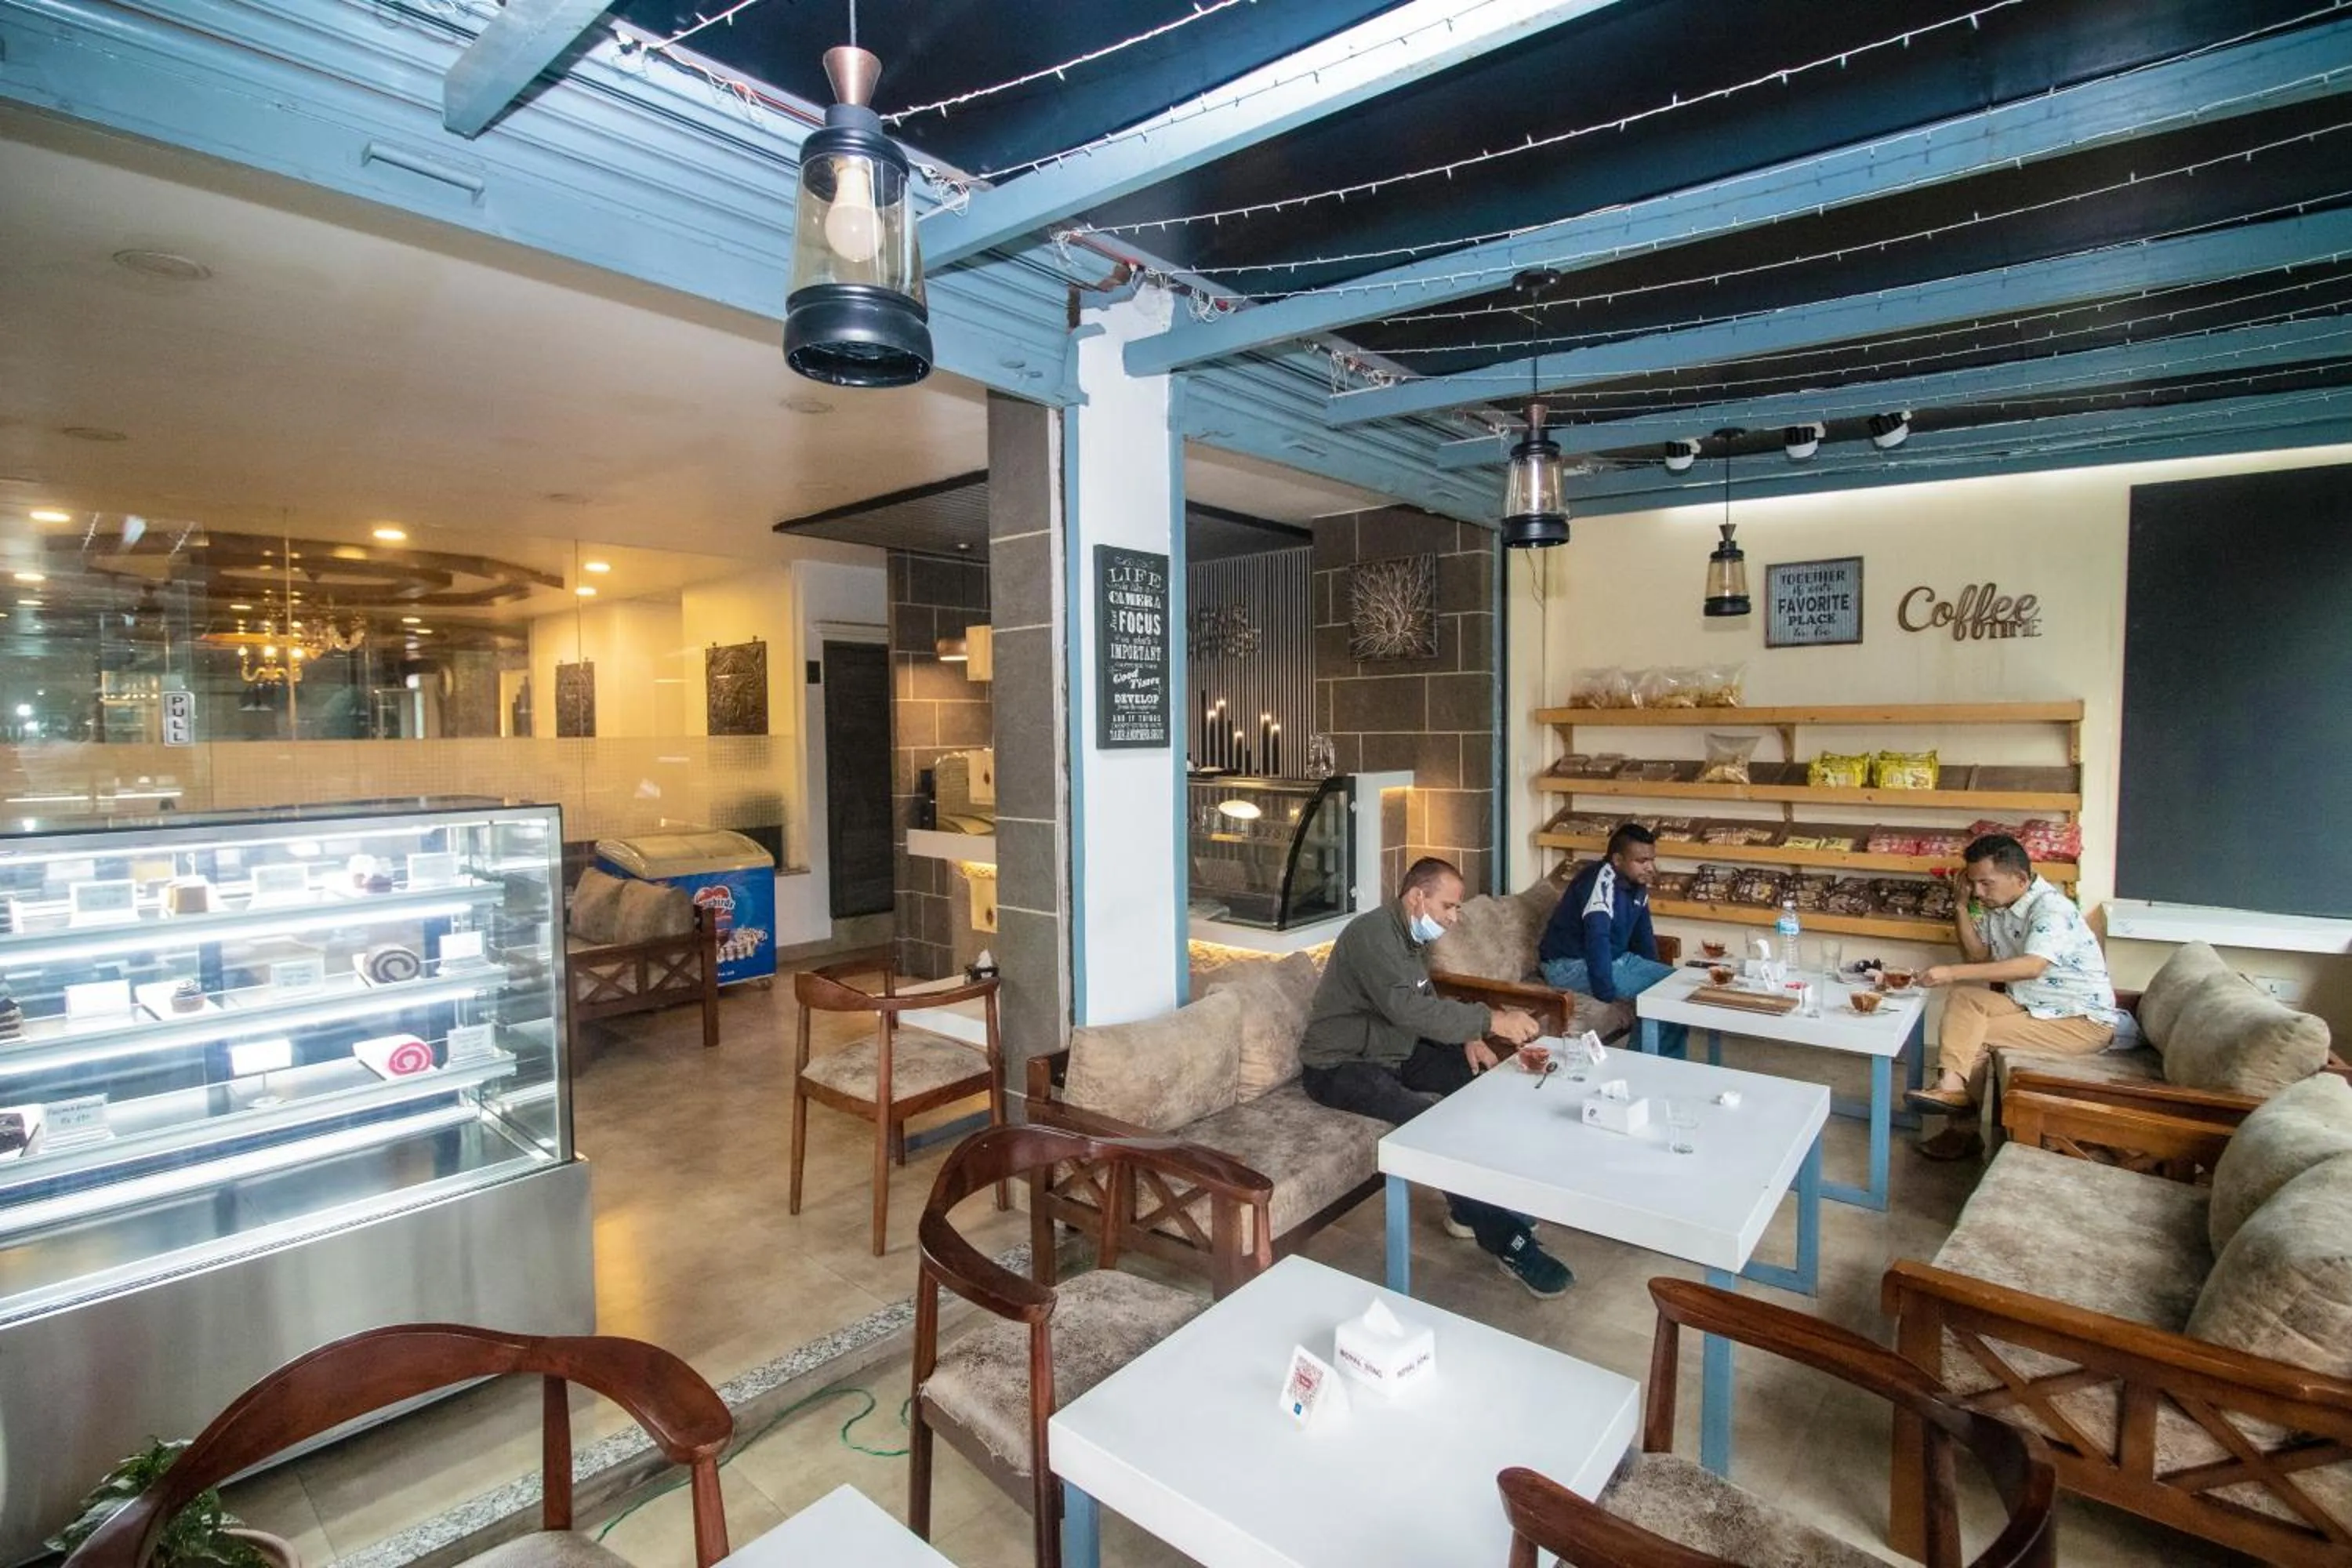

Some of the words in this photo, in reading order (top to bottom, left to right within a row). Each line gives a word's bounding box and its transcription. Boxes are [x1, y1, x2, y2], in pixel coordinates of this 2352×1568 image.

[1108, 567, 1162, 588] LIFE
[1781, 570, 1846, 585] TOGETHER
[1108, 590, 1162, 609] CAMERA
[1777, 593, 1849, 615] FAVORITE
[1788, 613, 1836, 626] PLACE
[1897, 582, 2041, 641] Coffee
[1118, 610, 1161, 636] FOCUS
[1109, 642, 1162, 661] IMPORTANT
[1113, 693, 1160, 704] DEVELOP
[171, 695, 185, 742] PULL
